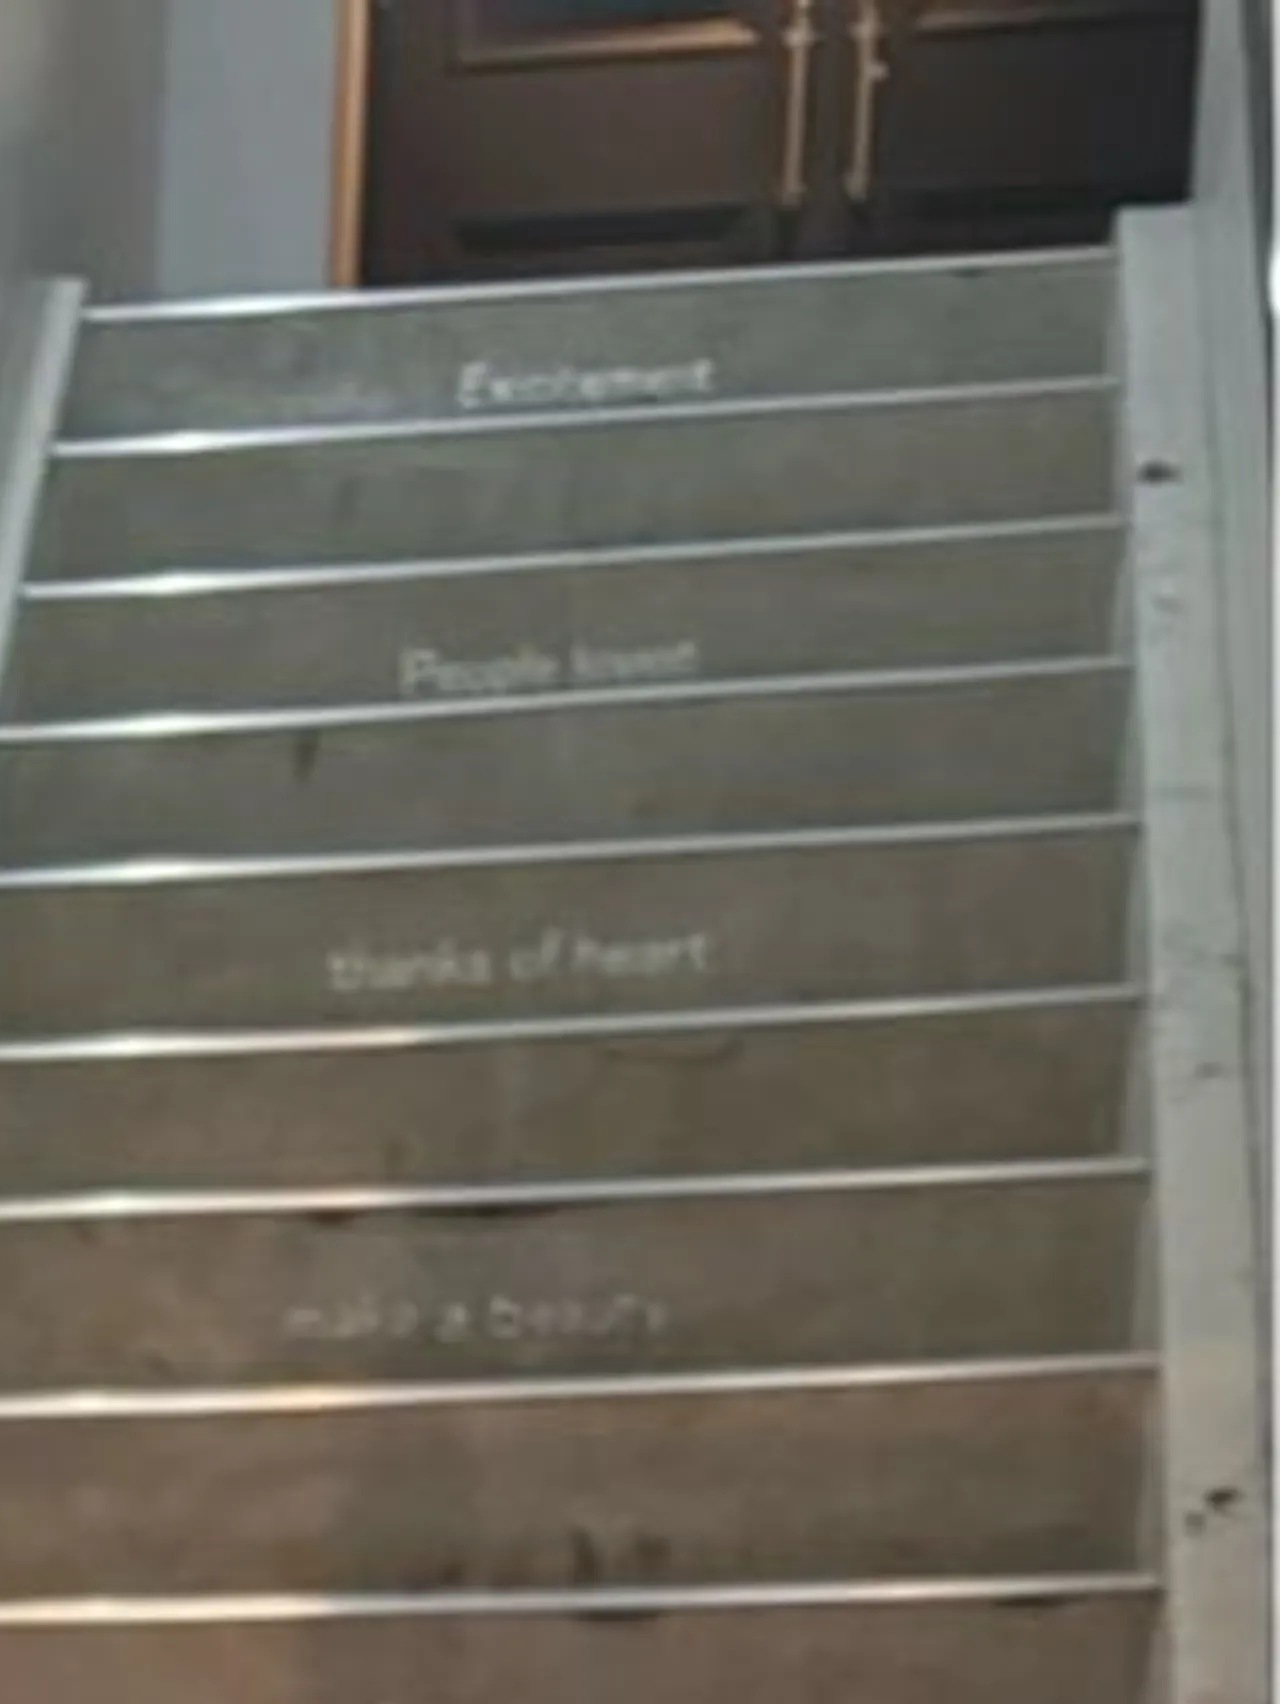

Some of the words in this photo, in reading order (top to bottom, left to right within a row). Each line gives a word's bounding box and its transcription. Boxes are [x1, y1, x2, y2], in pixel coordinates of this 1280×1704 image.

[326, 937, 491, 992] thanks
[510, 927, 564, 982] of
[570, 931, 708, 977] heart
